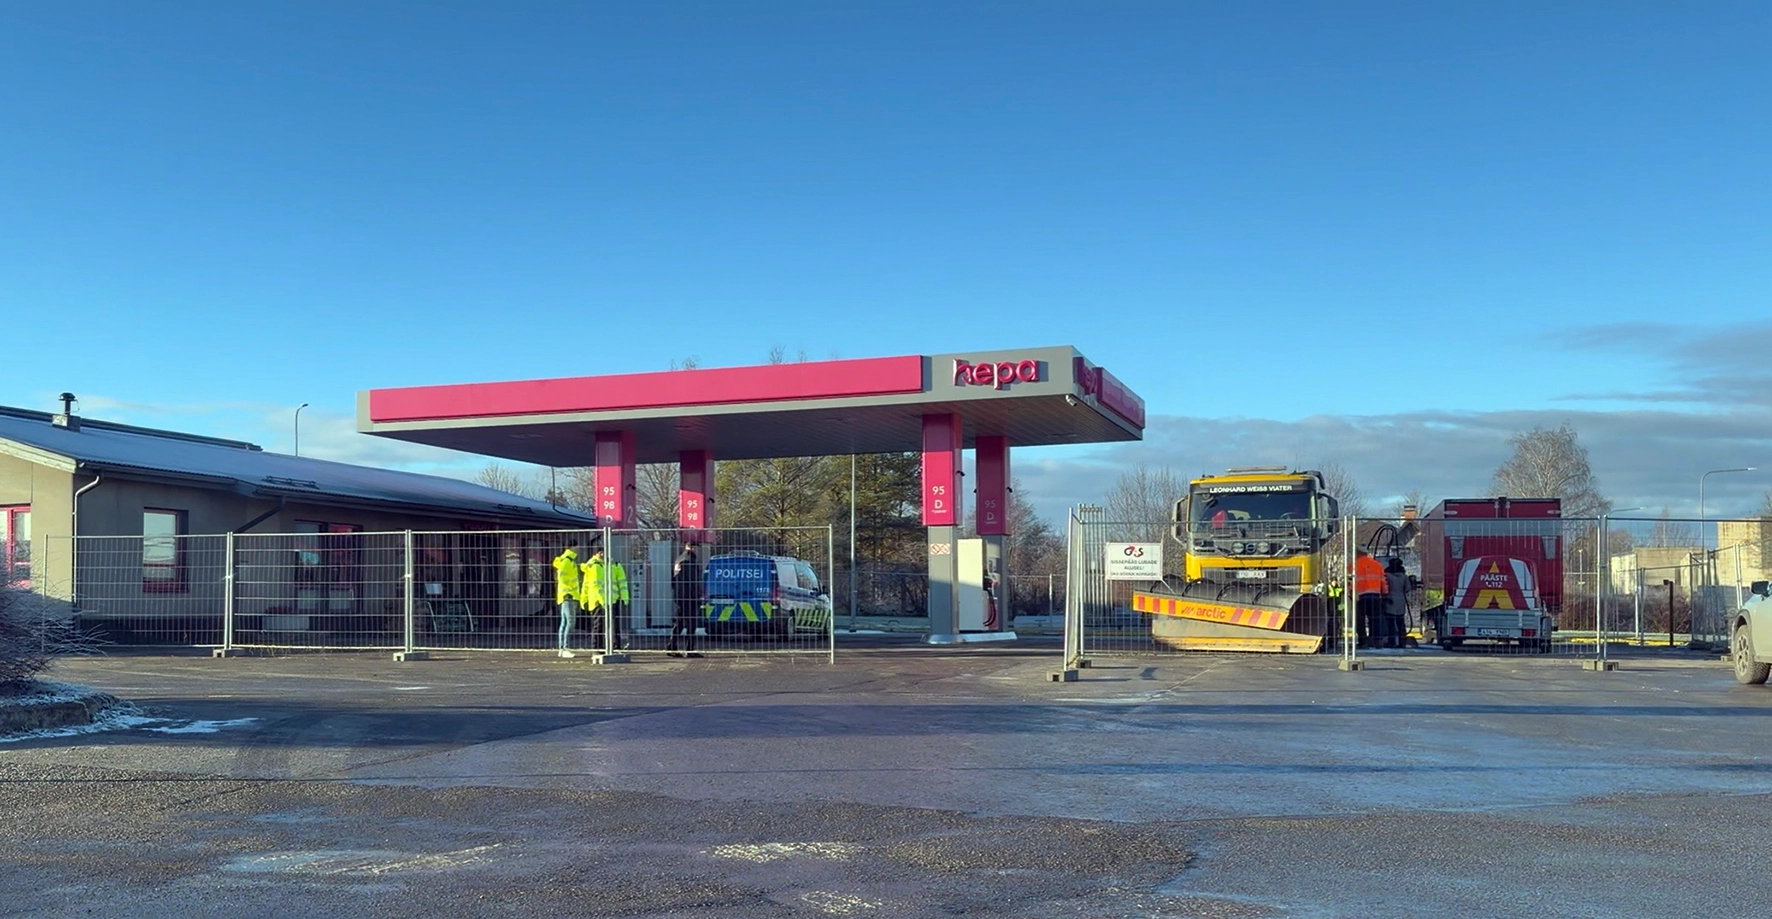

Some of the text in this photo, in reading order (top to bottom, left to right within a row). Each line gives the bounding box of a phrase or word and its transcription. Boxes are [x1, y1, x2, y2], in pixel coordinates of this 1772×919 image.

[953, 358, 1039, 390] hepa
[603, 487, 615, 496] 95
[932, 486, 945, 495] 95
[603, 501, 615, 510] 98
[687, 500, 698, 508] 95
[934, 499, 943, 509] D
[984, 500, 996, 508] 95
[605, 514, 613, 524] D
[627, 506, 634, 524] 2
[687, 512, 698, 521] 98
[987, 512, 994, 520] D
[715, 569, 763, 578] POLITSEI
[1480, 573, 1508, 581] PÄÄSTE
[1196, 607, 1226, 619] arctic
